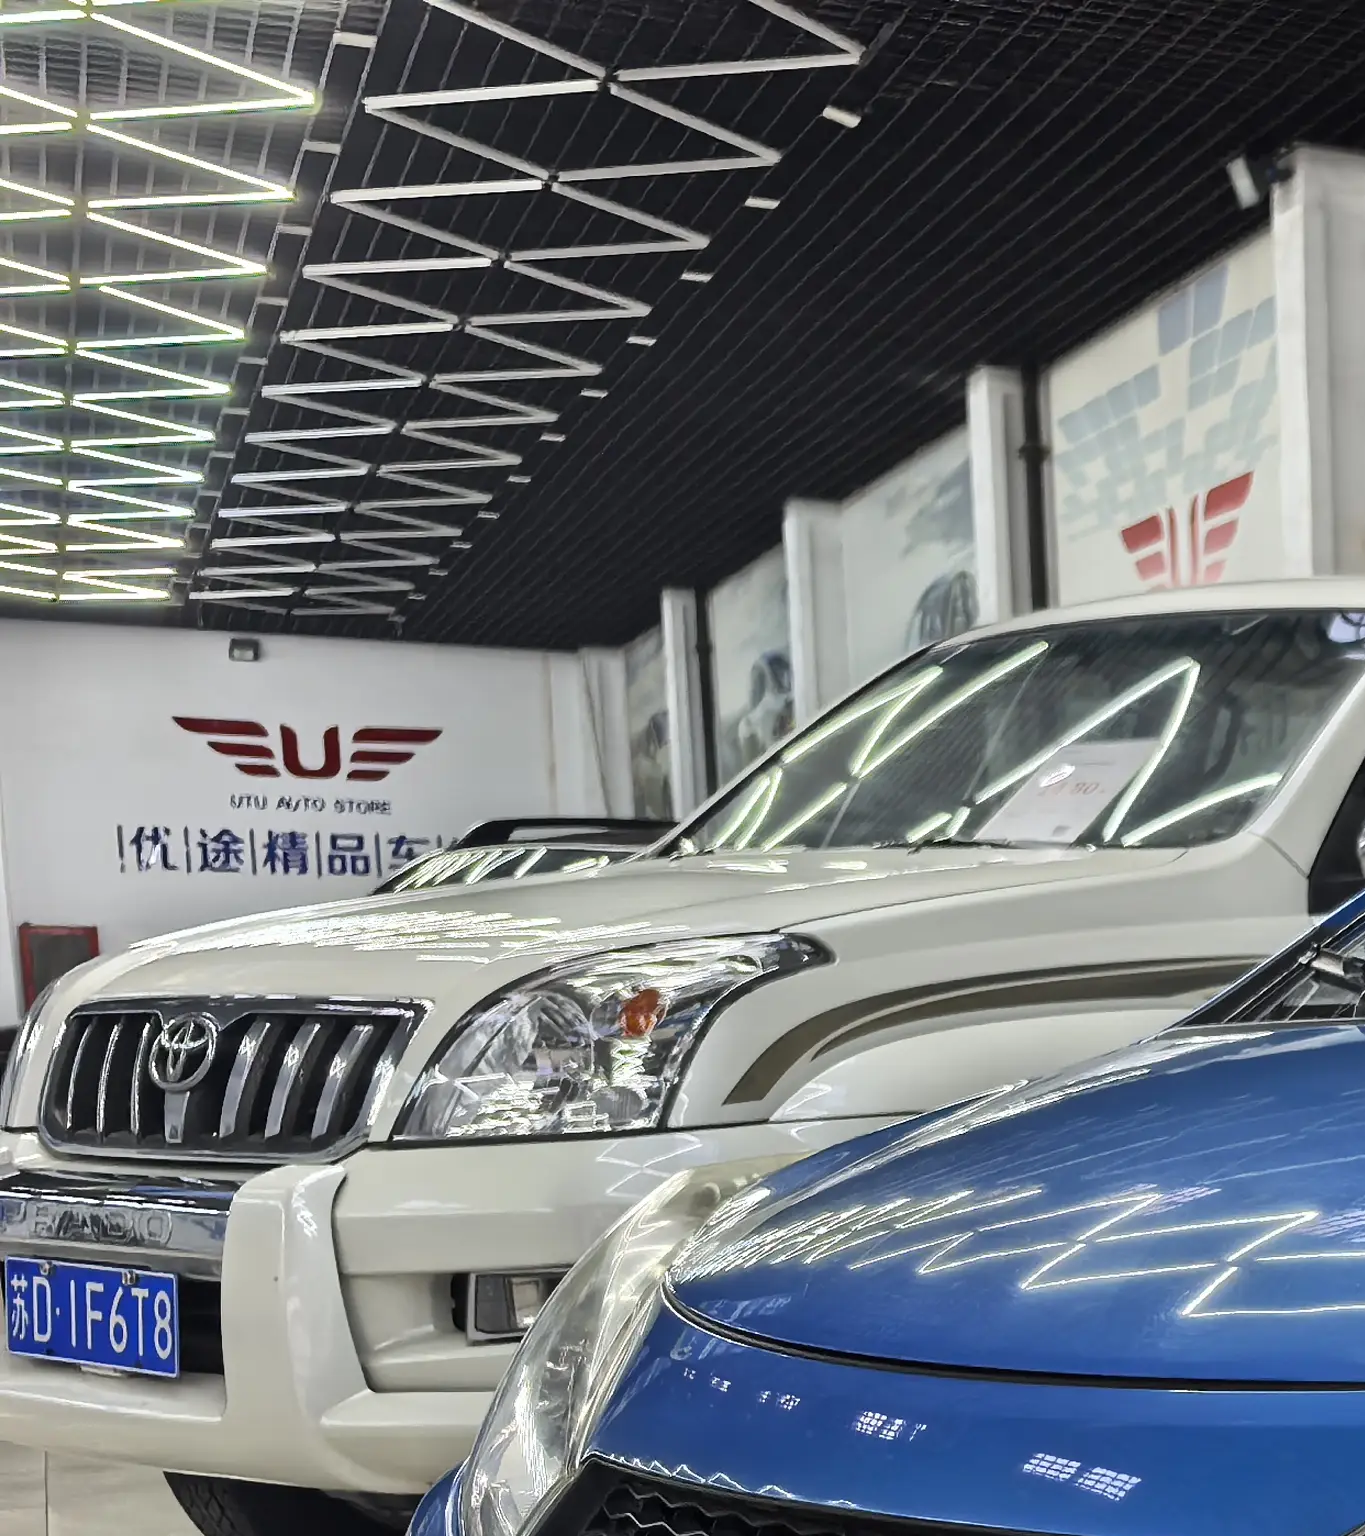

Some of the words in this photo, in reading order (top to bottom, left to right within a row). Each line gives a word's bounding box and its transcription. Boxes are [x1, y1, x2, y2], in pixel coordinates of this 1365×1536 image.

[230, 794, 268, 811] UTU
[276, 794, 326, 812] AUTO
[333, 799, 392, 815] STORE
